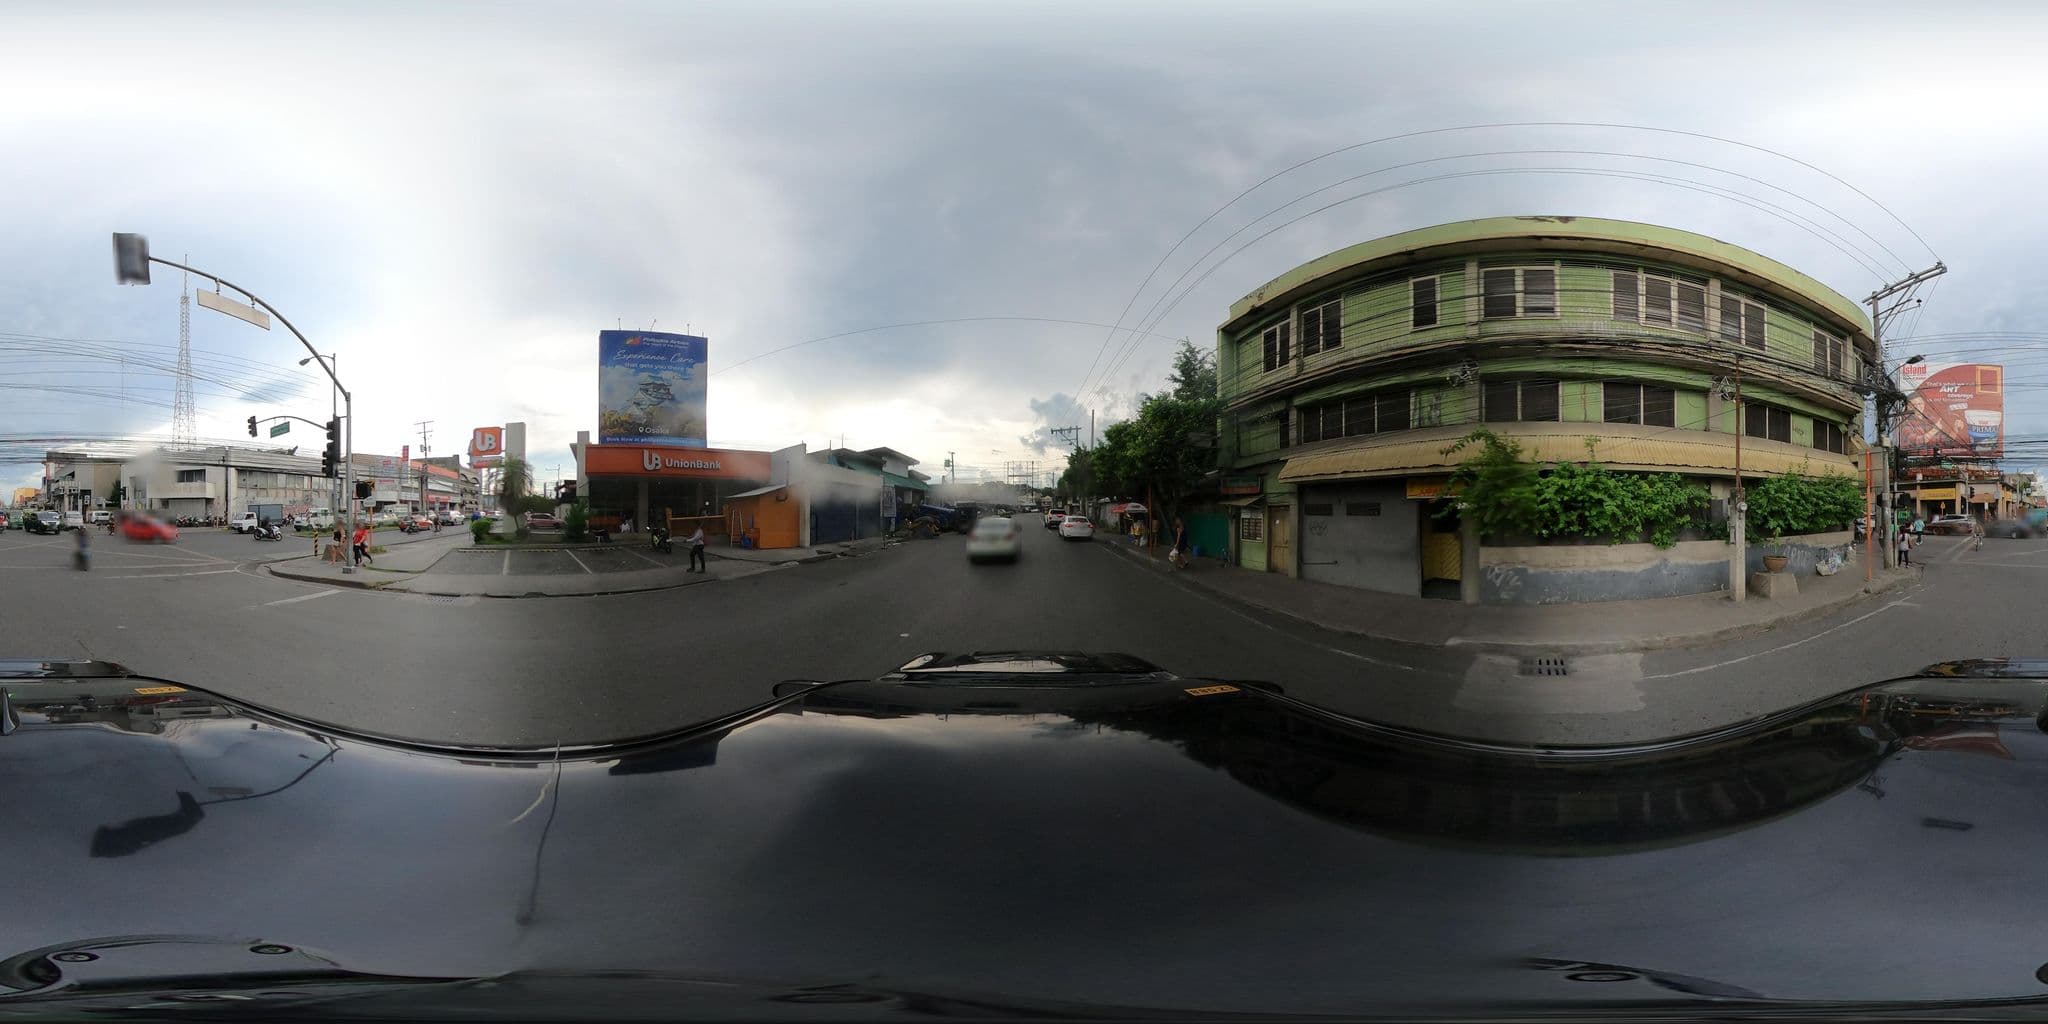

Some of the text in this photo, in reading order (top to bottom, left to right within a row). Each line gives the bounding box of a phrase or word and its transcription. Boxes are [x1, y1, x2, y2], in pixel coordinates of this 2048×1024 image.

[616, 349, 695, 363] Experience Care
[1903, 365, 1926, 375] Island
[1939, 385, 1961, 393] ART
[665, 458, 721, 469] UnionBank
